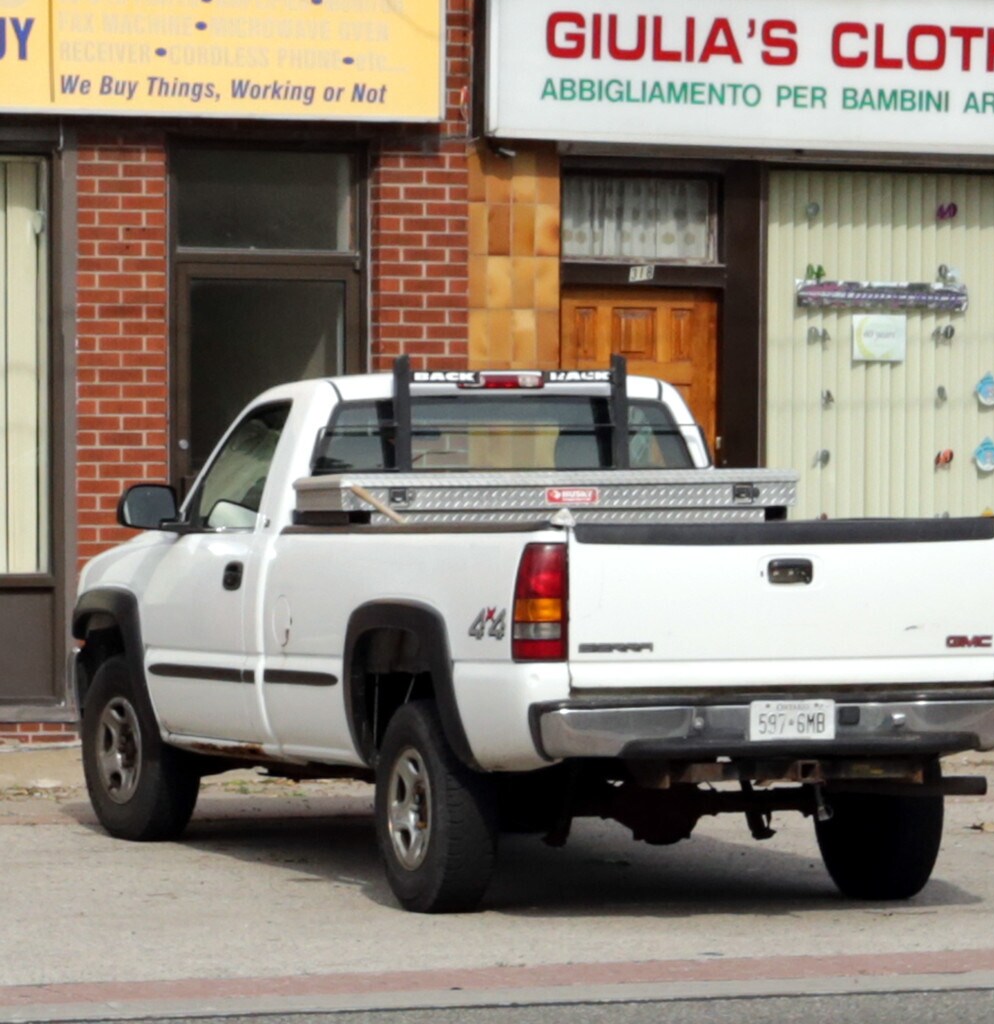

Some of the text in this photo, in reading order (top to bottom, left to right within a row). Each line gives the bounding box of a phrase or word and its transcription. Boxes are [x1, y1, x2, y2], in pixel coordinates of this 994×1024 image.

[59, 40, 152, 63] RECEIVER
[545, 11, 798, 66] GIULIA'S
[60, 75, 387, 106] We Buy Things, Working or Not
[541, 78, 761, 107] ABBIGLIAMENTO
[776, 86, 827, 109] PER
[842, 87, 950, 112] BAMBINI
[413, 371, 475, 382] BACK
[945, 634, 993, 648] GMC
